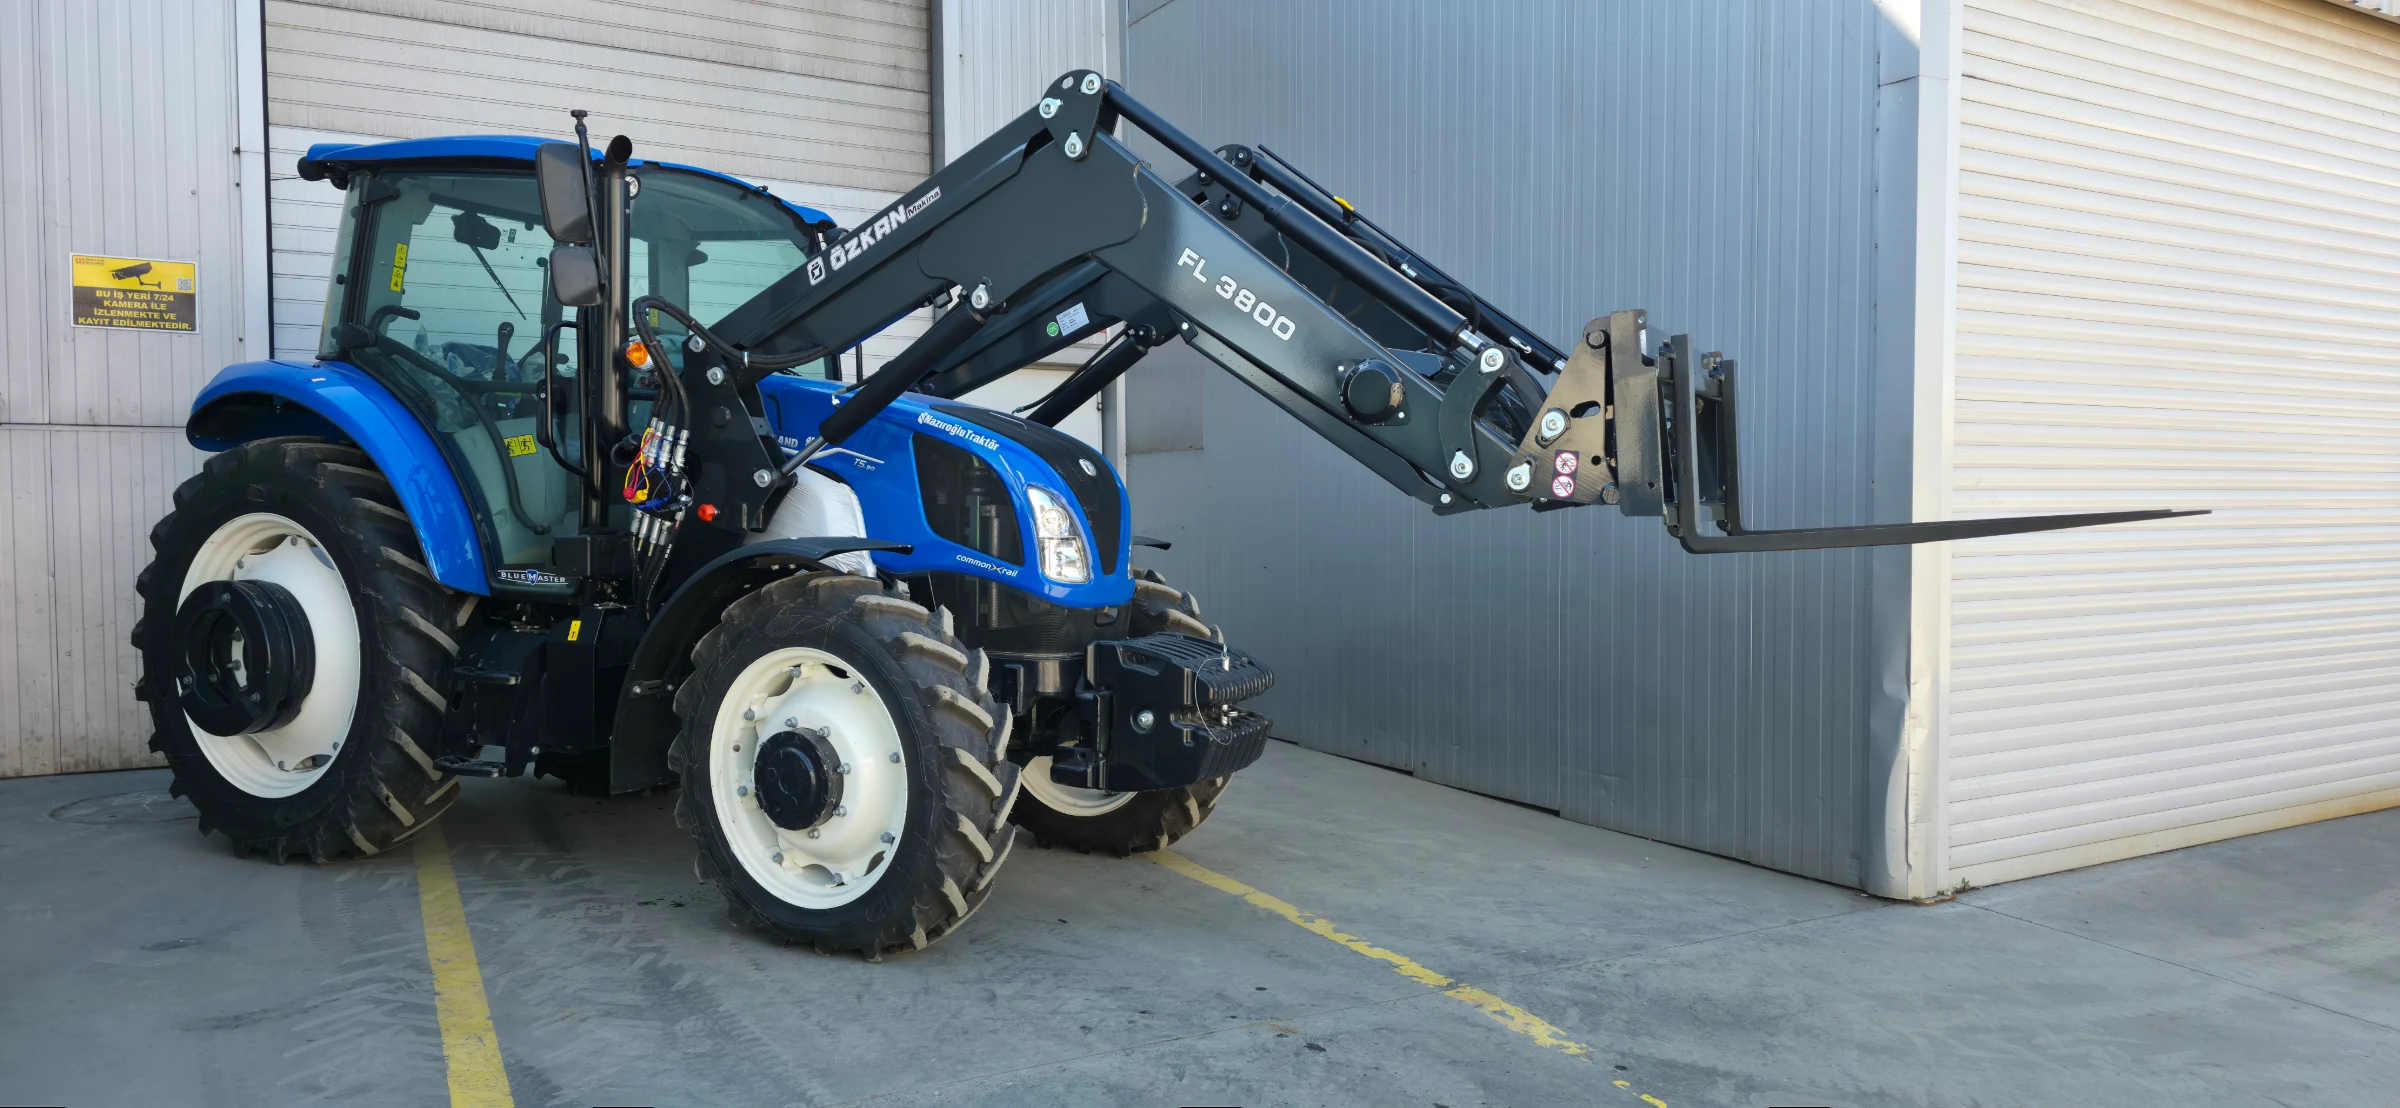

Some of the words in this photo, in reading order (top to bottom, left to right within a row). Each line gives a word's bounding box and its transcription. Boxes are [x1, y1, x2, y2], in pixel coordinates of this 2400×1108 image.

[829, 203, 909, 271] ÖZKAN
[906, 188, 941, 218] Makina
[95, 290, 111, 298] BU
[113, 289, 124, 299] İŞ
[126, 290, 151, 300] YERİ
[153, 293, 175, 302] 7/24
[1177, 247, 1208, 284] FL
[1215, 274, 1296, 341] 3800
[103, 300, 148, 309] KAMERA
[150, 301, 167, 311] İLE
[93, 307, 161, 319] İZLENMEKTE
[163, 312, 177, 320] VE
[78, 317, 110, 326] KAYIT
